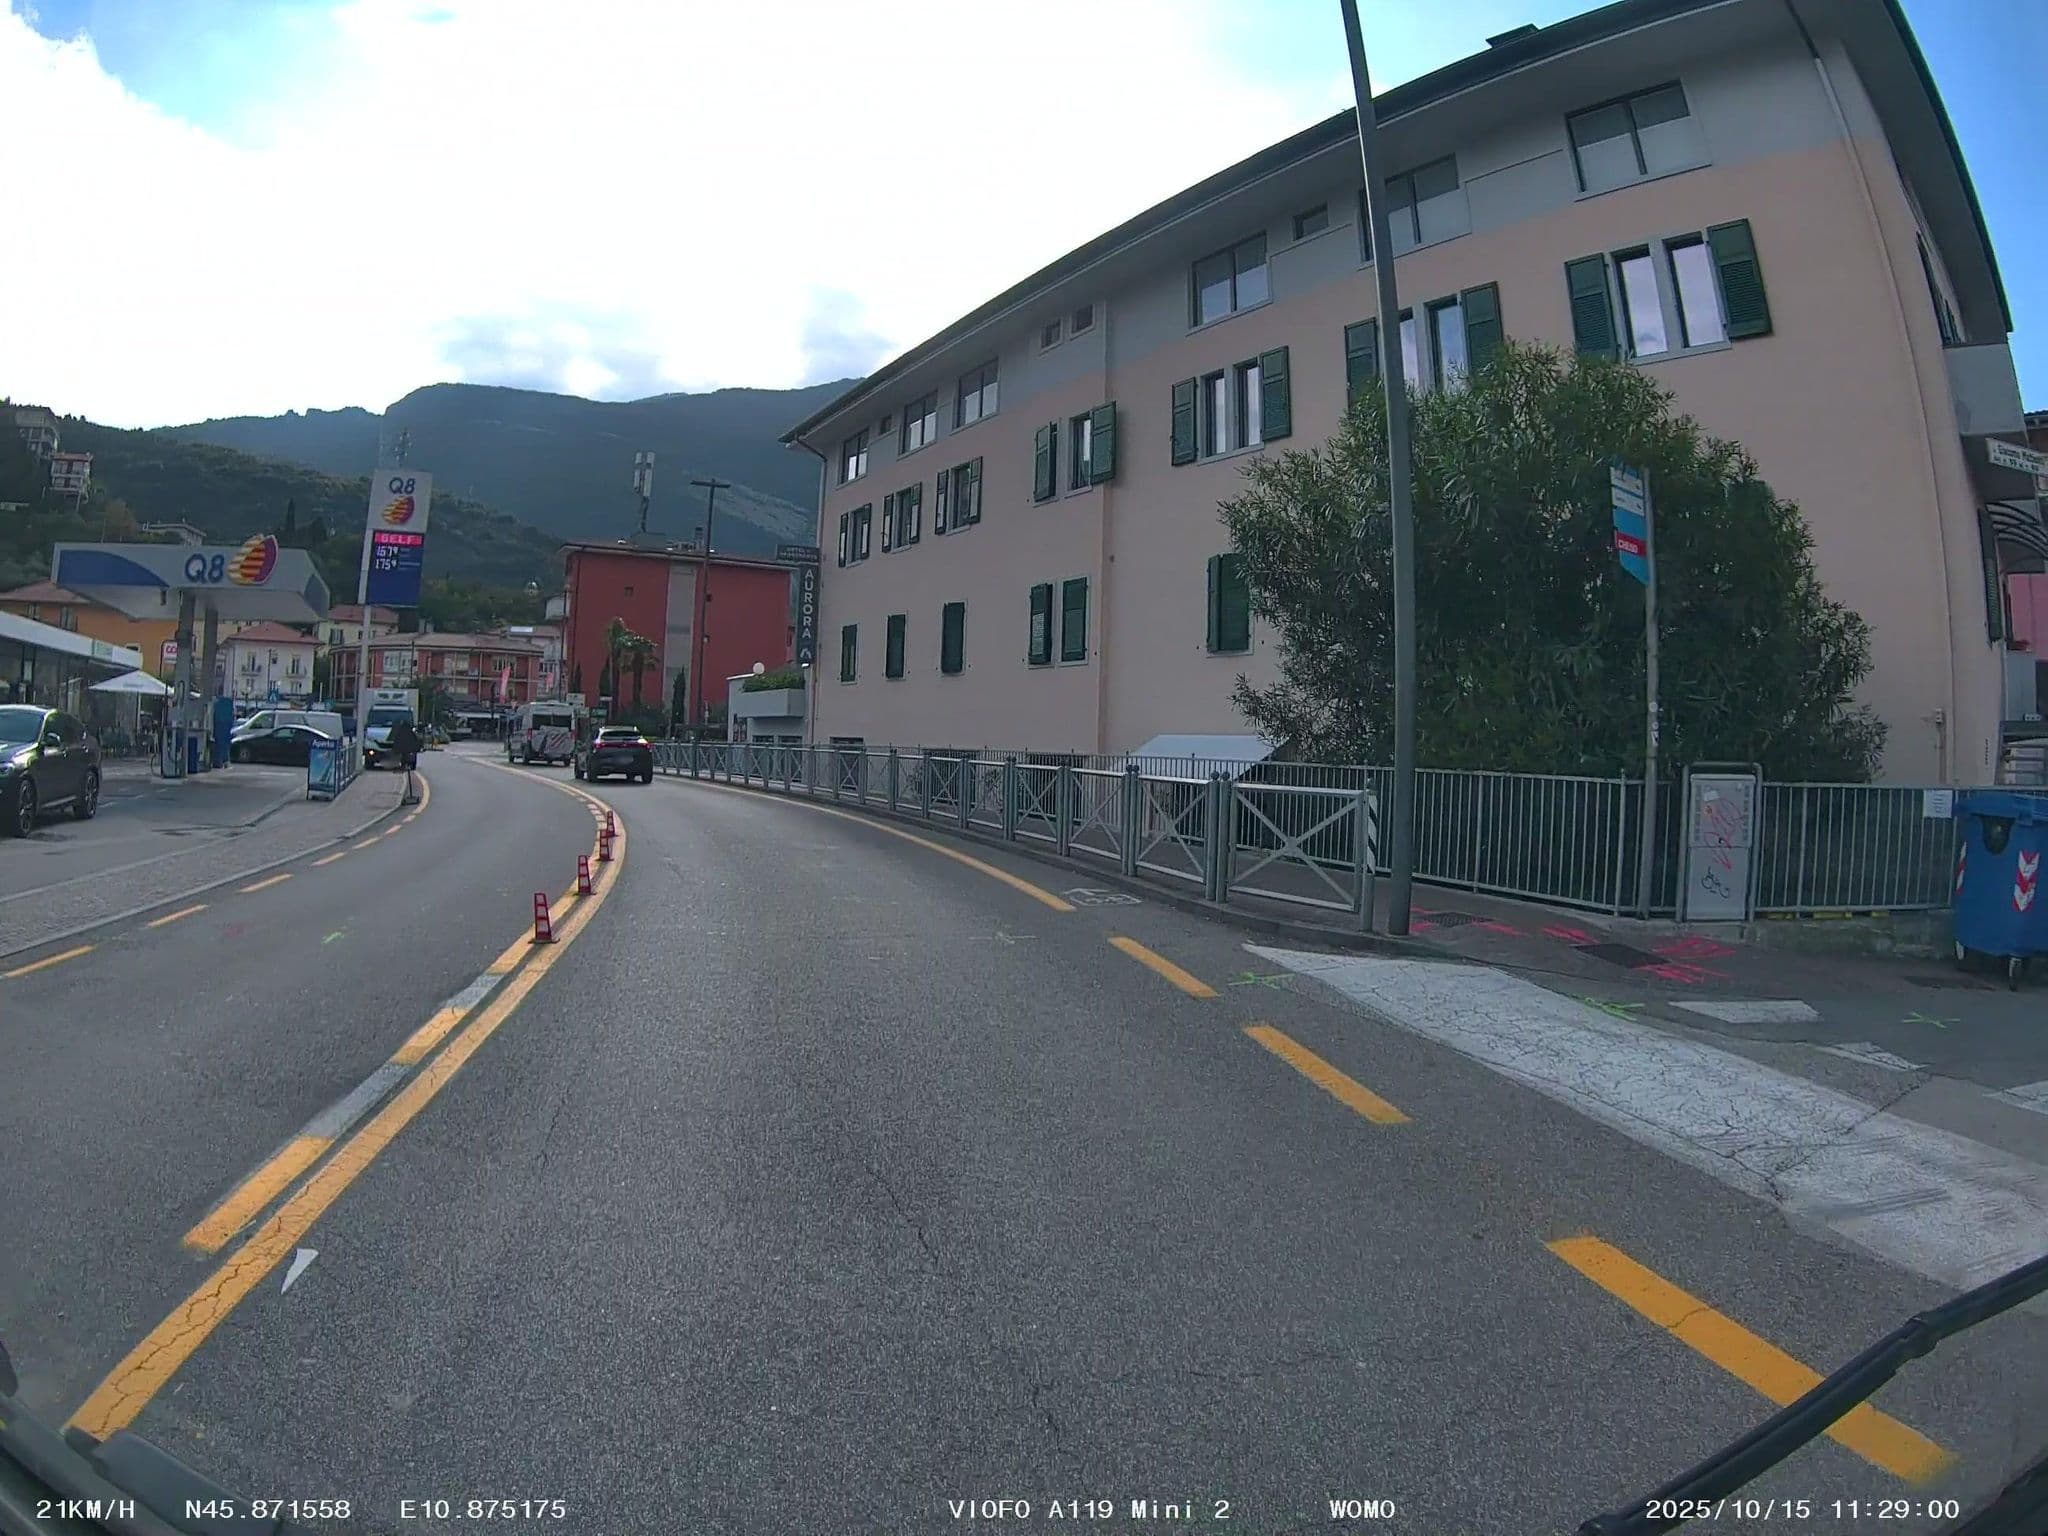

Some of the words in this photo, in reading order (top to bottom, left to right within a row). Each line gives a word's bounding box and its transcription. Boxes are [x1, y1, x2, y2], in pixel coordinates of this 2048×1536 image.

[389, 477, 415, 494] Q8
[381, 533, 413, 545] SELF
[185, 553, 224, 584] Q8
[802, 569, 814, 639] AURORA
